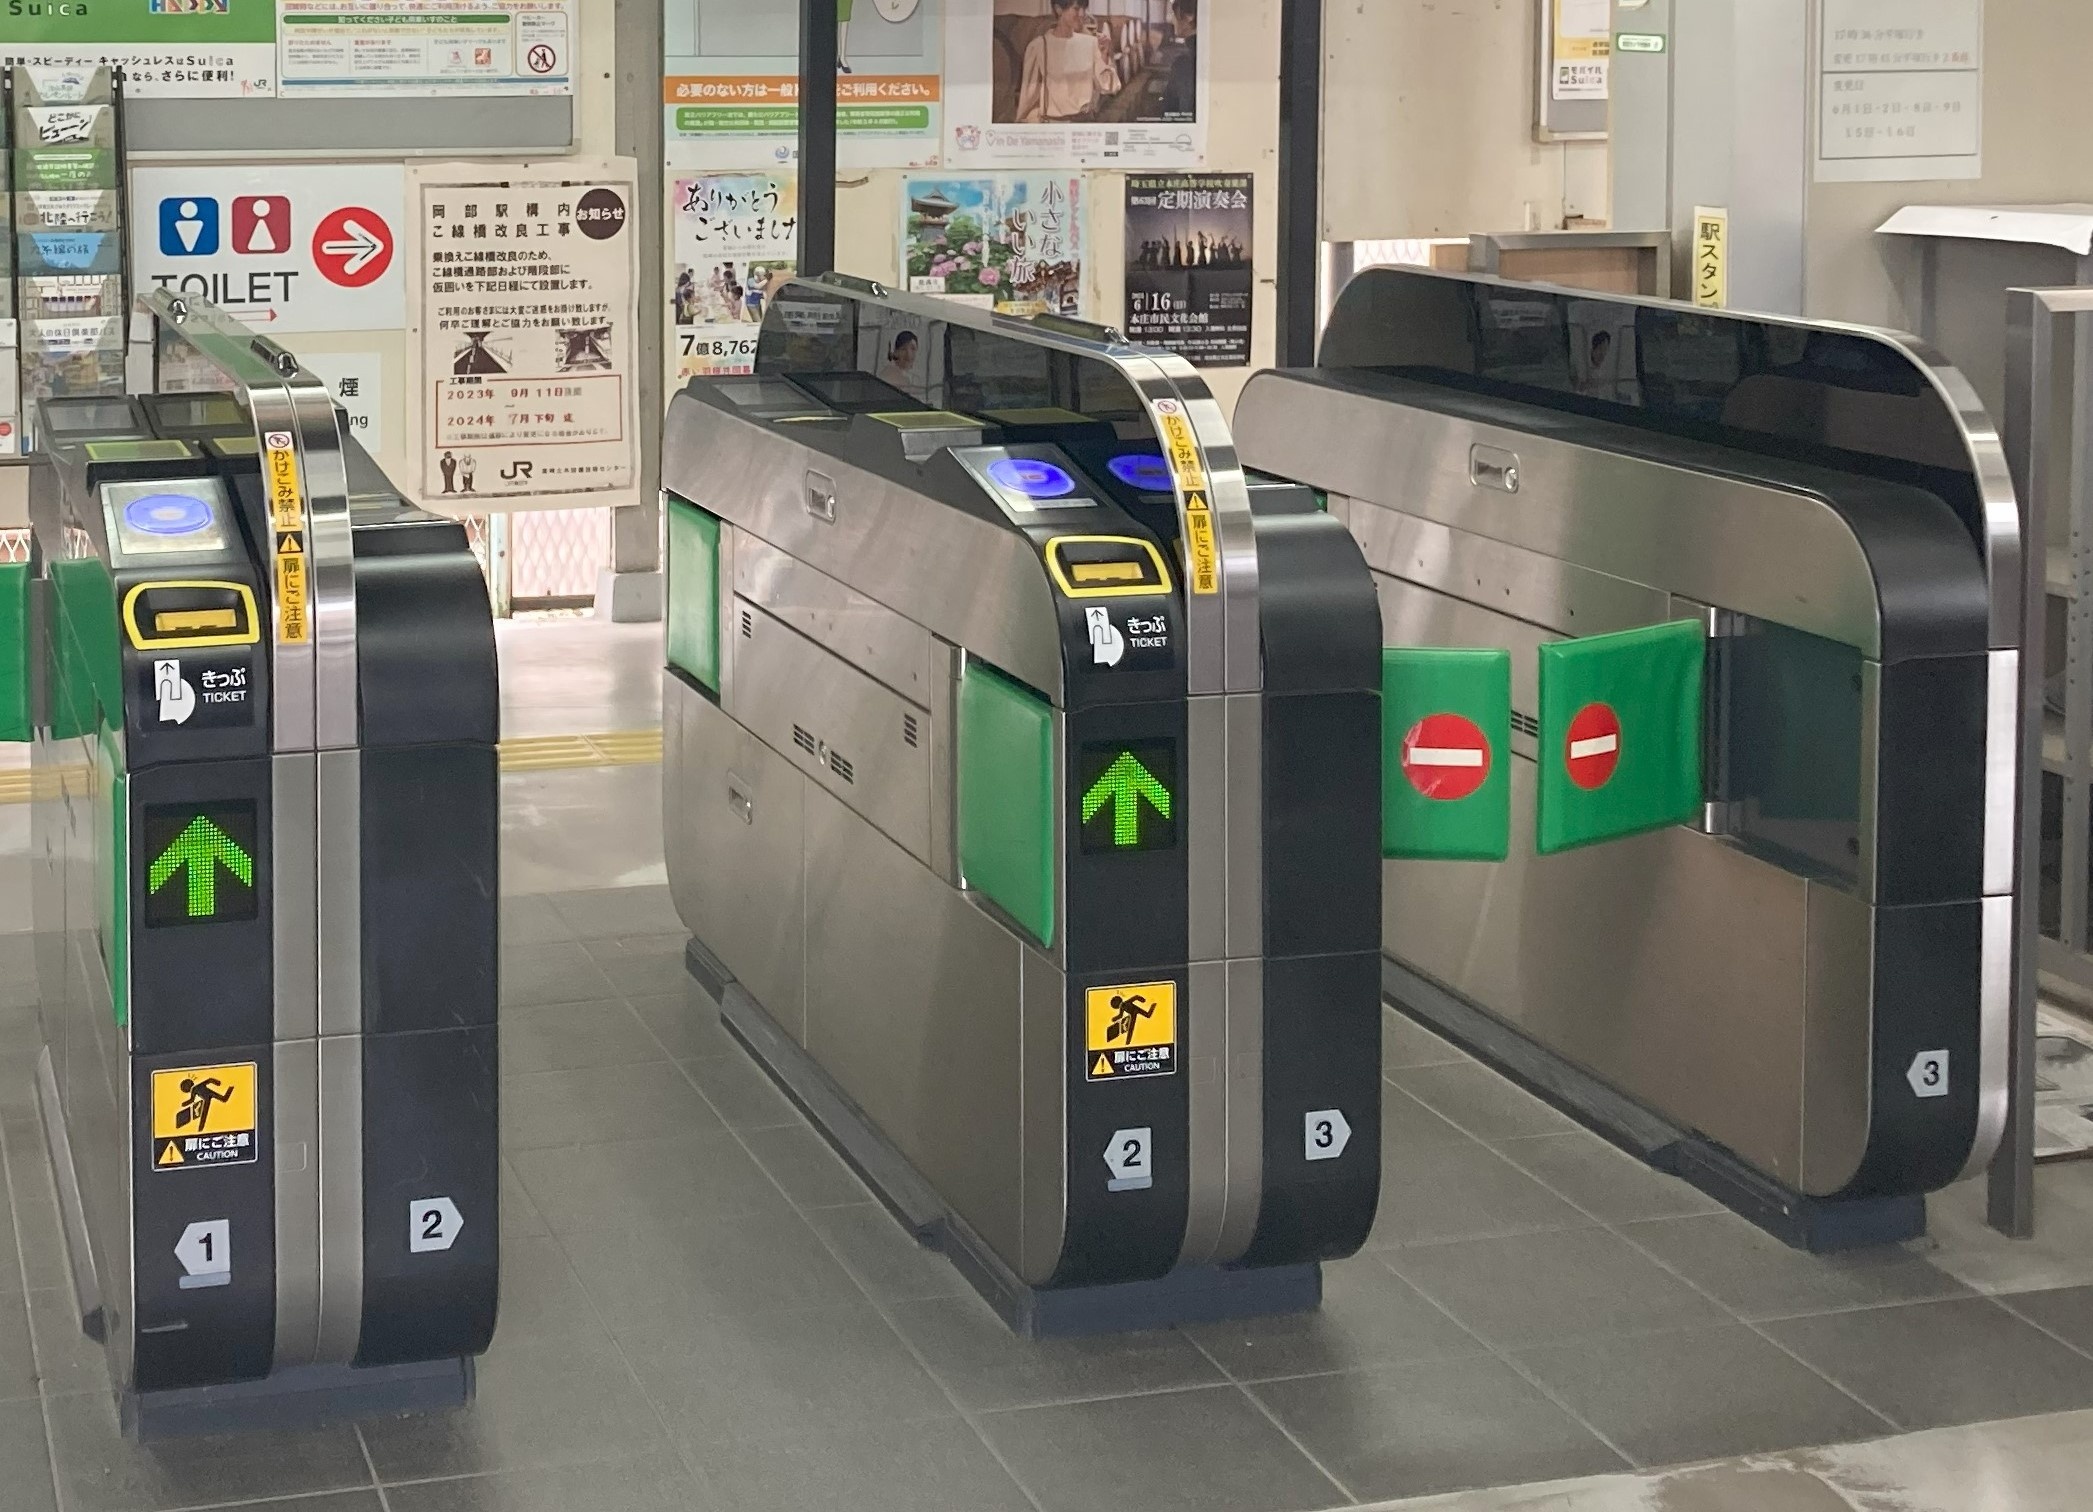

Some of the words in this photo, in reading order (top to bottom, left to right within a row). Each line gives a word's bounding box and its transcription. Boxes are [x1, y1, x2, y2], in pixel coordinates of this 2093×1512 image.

[8, 0, 88, 16] Suica
[682, 182, 779, 213] ありがとう
[1156, 189, 1248, 210] 定期演奏会
[576, 207, 625, 221] お知らせ
[1041, 180, 1065, 257] 小さな
[1010, 207, 1036, 284] いい旅
[1151, 292, 1172, 311] 16
[1166, 415, 1200, 487] かけこみ禁止
[500, 460, 534, 479] JR
[273, 450, 298, 528] かけこみ禁止
[1191, 514, 1214, 590] 扉にご注意
[282, 557, 303, 640] 扉にご注意
[1129, 636, 1168, 648] TICKET
[202, 690, 247, 703] TICKET
[1124, 1061, 1160, 1072] CAUTION
[1922, 1060, 1940, 1086] 3
[1314, 1120, 1334, 1148] 3
[196, 1149, 239, 1160] CAUTION
[1122, 1139, 1142, 1168] 2
[421, 1209, 444, 1240] 2
[198, 1232, 213, 1262] 1
